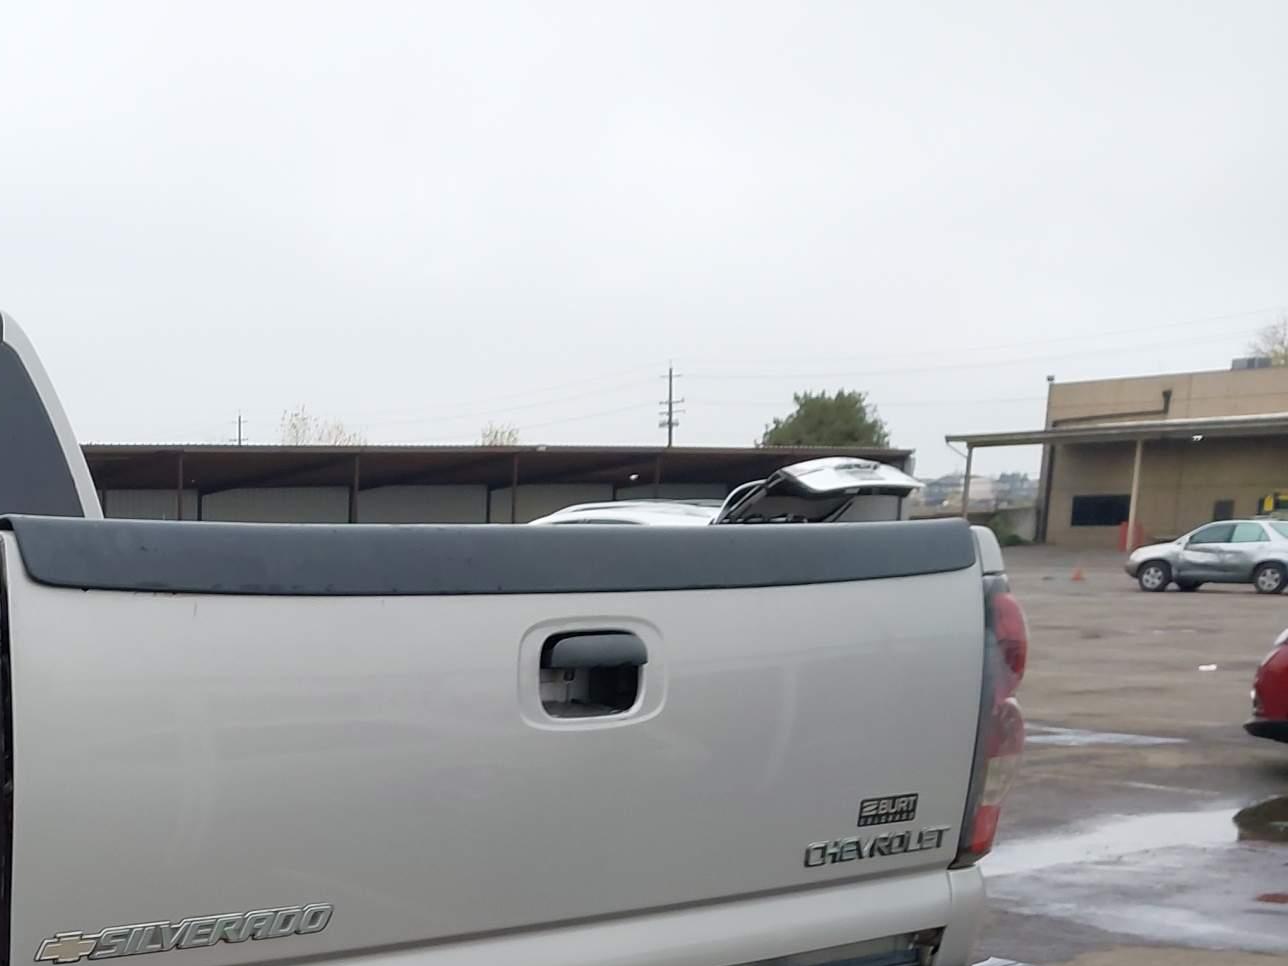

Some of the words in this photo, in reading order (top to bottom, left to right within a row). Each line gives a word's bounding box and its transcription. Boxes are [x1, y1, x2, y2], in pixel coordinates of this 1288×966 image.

[877, 796, 917, 815] BURT
[804, 825, 951, 868] CHEVROLET
[88, 902, 334, 960] SILVERADO
